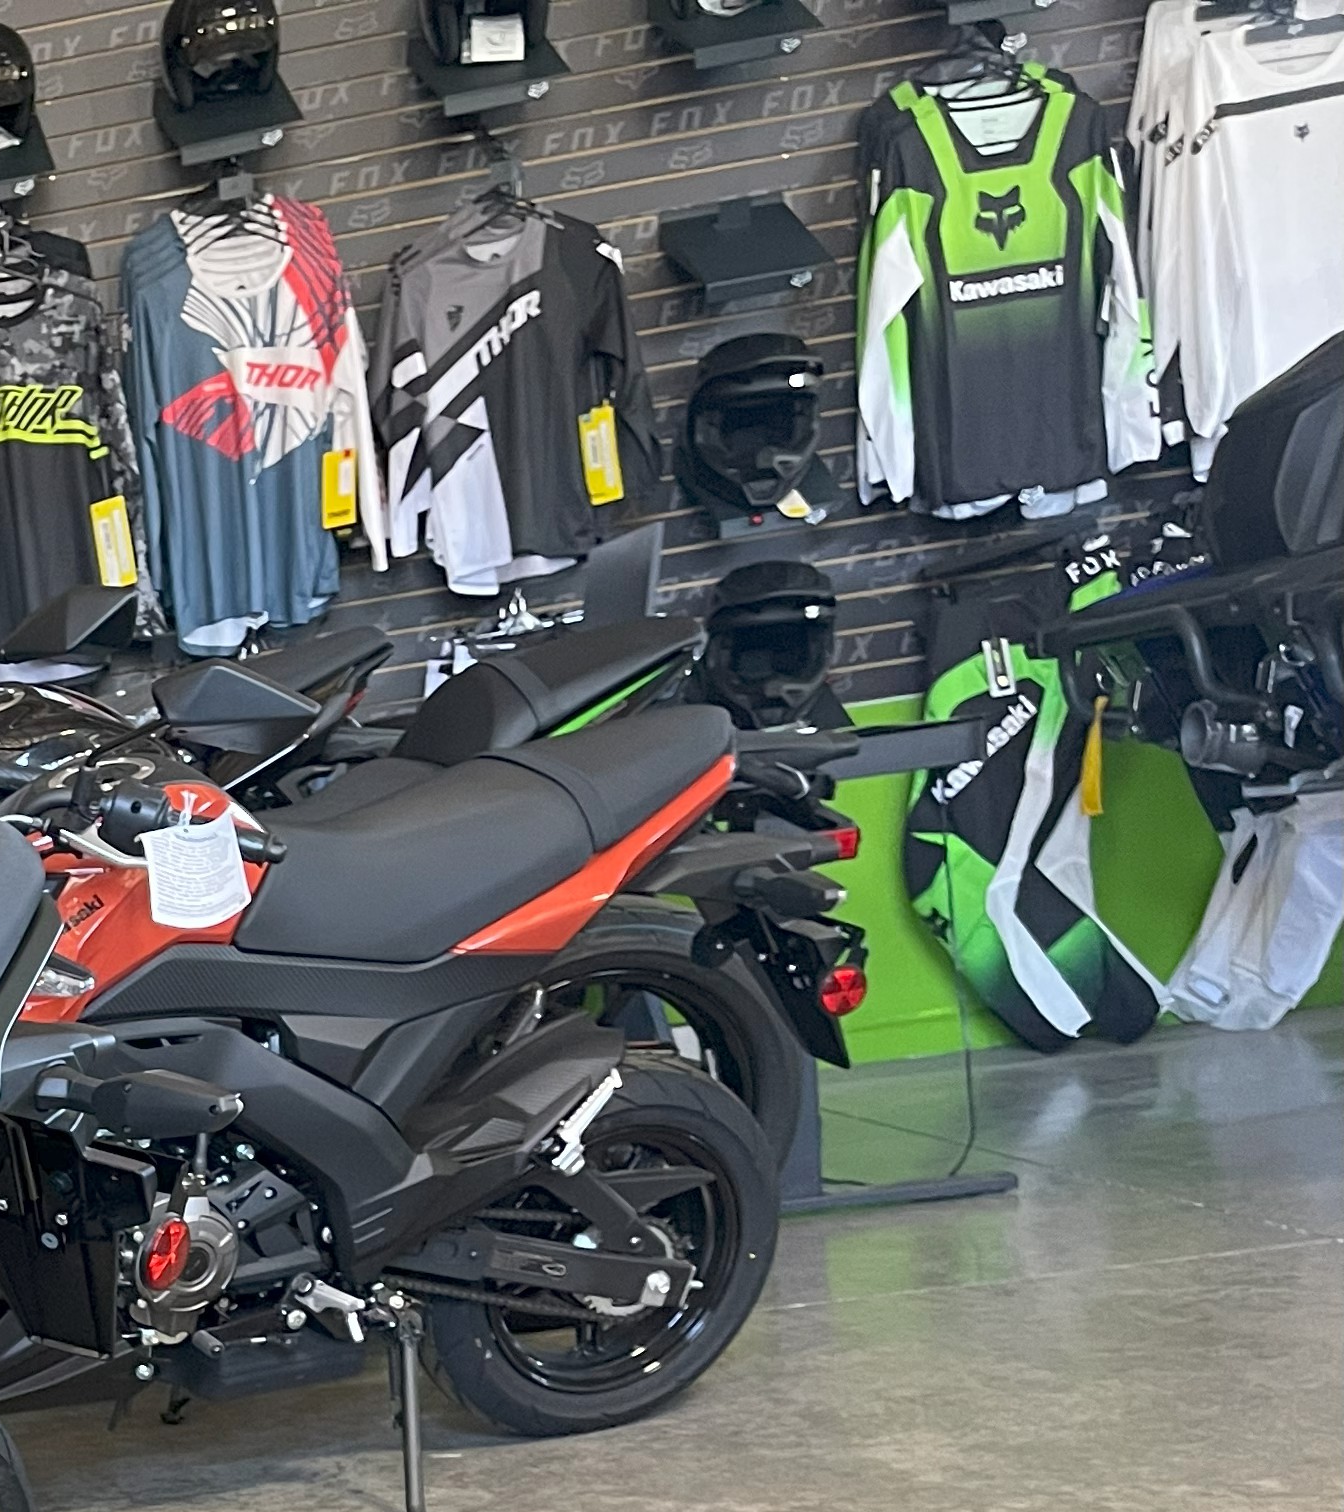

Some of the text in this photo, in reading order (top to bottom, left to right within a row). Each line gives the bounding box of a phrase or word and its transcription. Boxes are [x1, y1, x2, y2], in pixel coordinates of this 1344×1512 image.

[33, 34, 82, 63] OX
[110, 21, 159, 52] FO
[68, 123, 143, 158] FOX
[301, 84, 351, 111] OX
[330, 159, 411, 196] FOX
[541, 121, 625, 156] FOX
[651, 101, 733, 137] FOX
[762, 80, 846, 118] FOX
[949, 264, 1064, 302] Kawasaki
[475, 290, 542, 366] THOR
[246, 362, 321, 393] THOR
[1065, 549, 1122, 584] FOX
